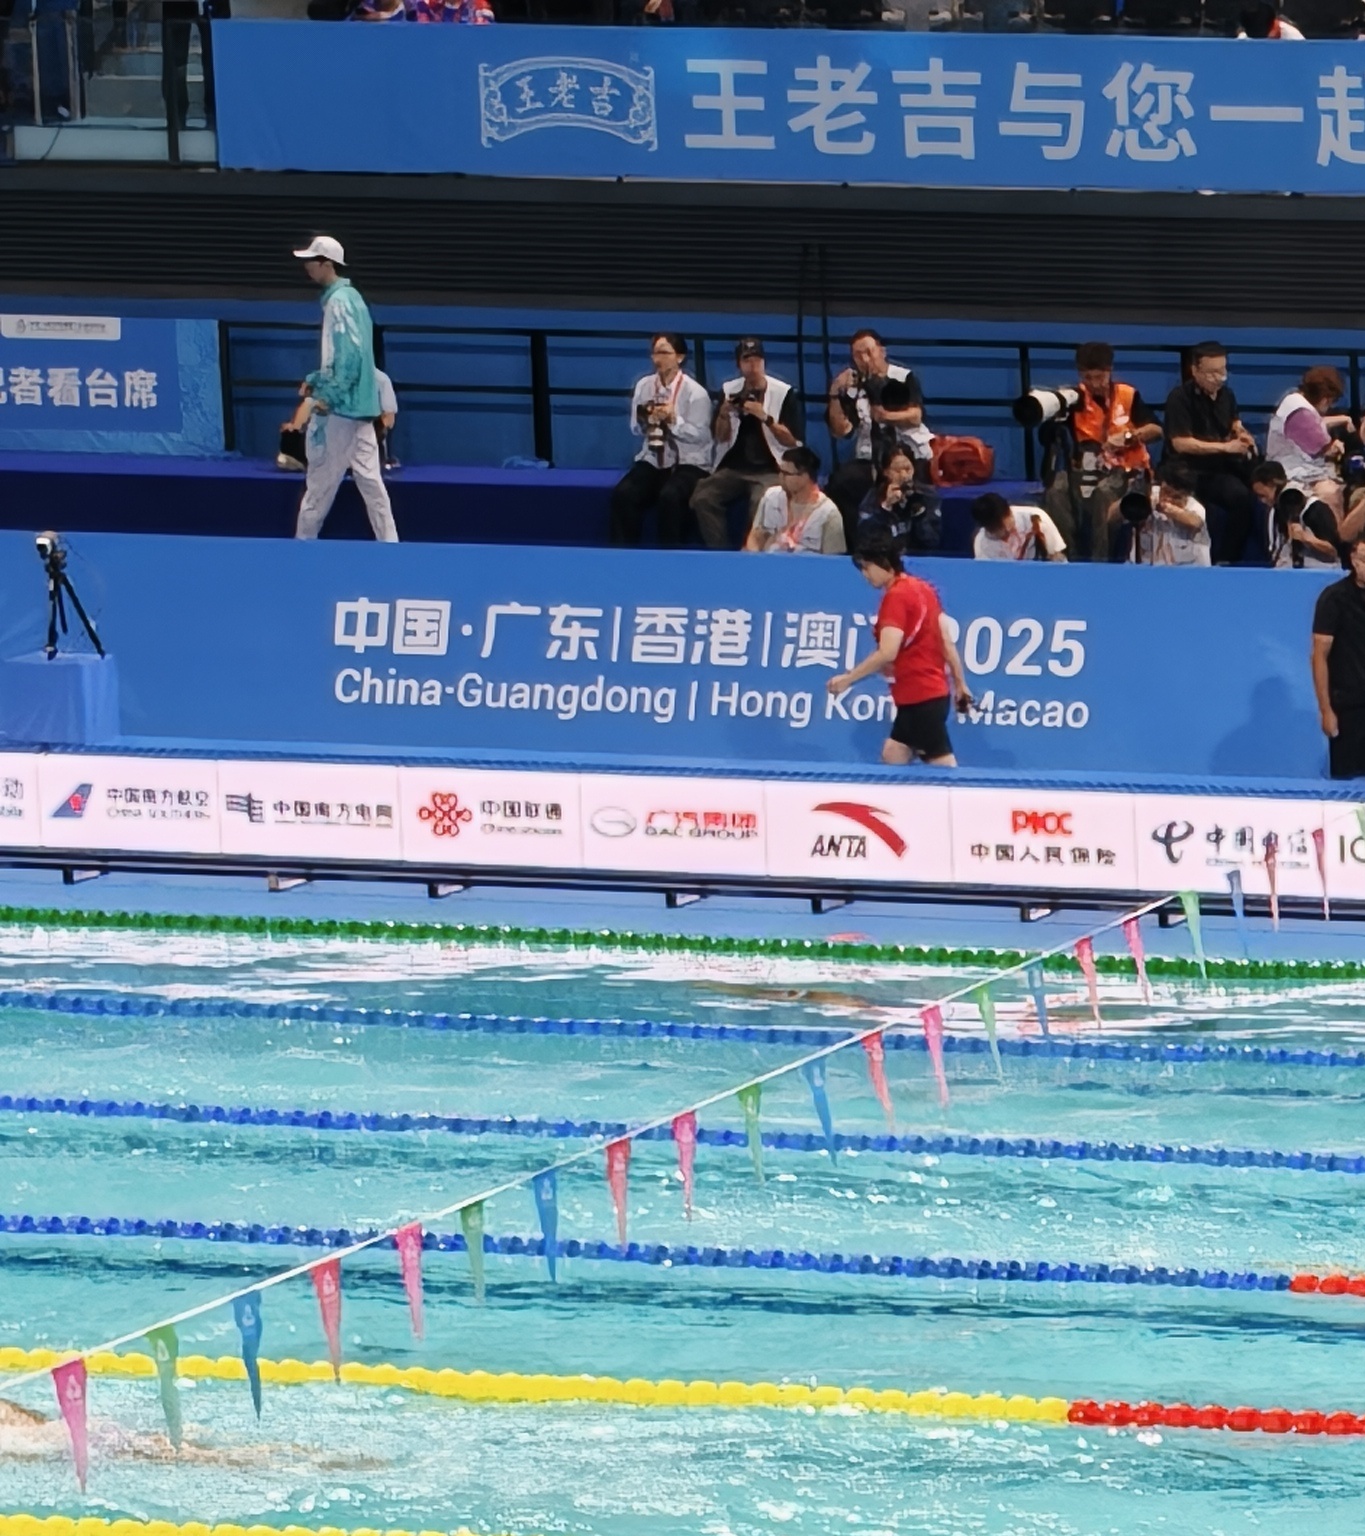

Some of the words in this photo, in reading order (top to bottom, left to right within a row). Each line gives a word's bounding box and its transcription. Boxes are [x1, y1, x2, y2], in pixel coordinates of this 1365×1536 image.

[940, 616, 1088, 678] 025
[710, 682, 812, 729] Hong
[824, 686, 898, 722] Kon
[811, 835, 867, 858] ANTA
